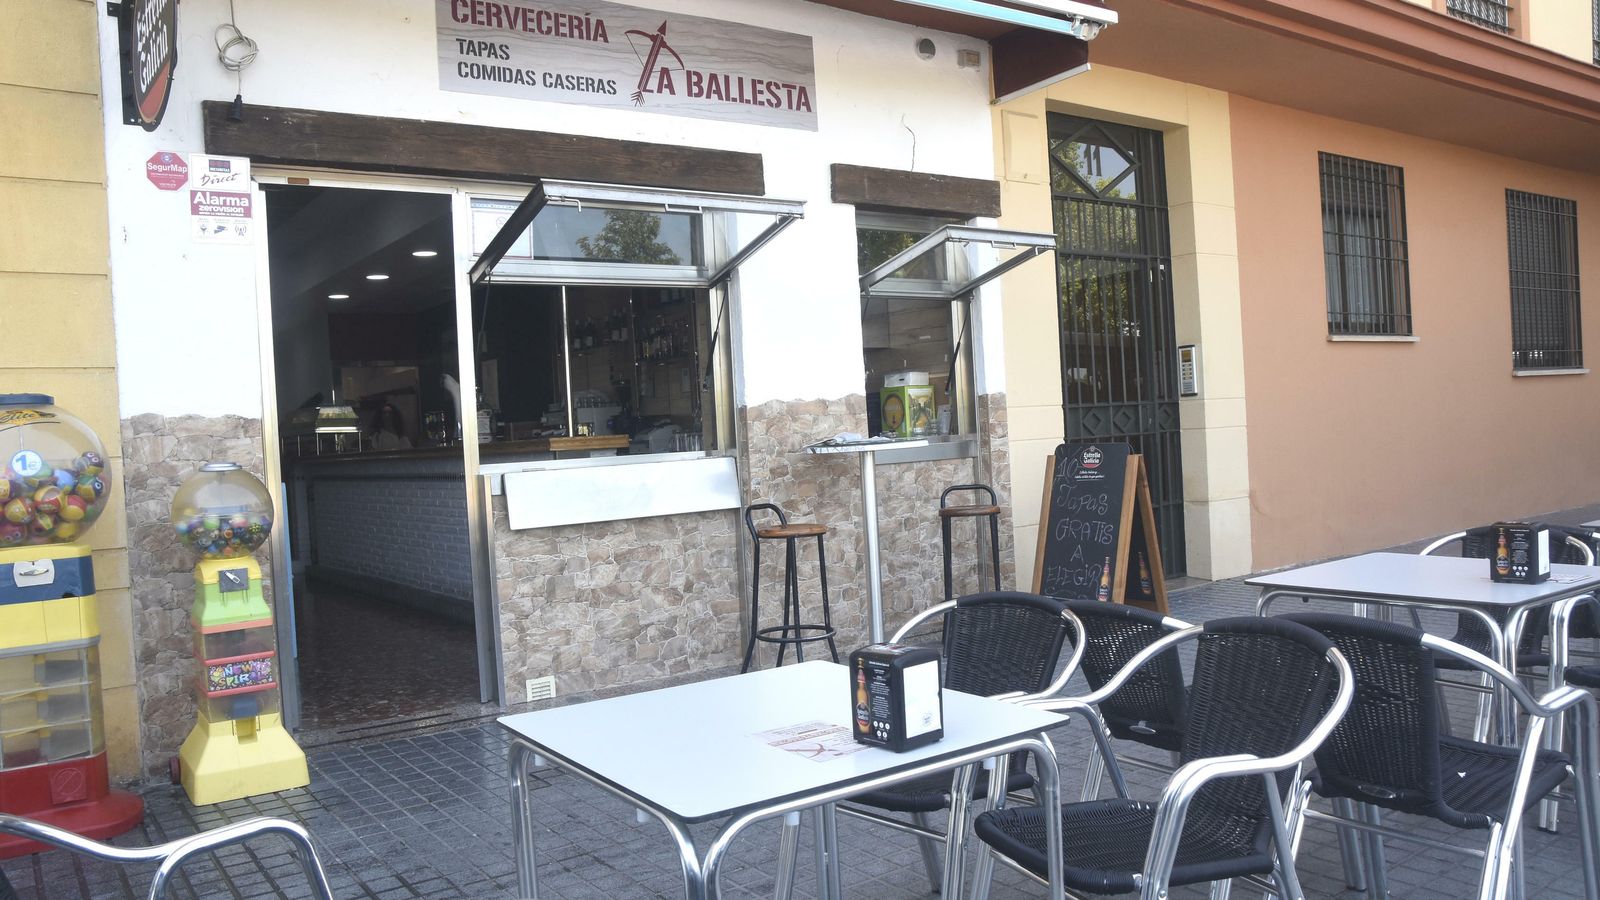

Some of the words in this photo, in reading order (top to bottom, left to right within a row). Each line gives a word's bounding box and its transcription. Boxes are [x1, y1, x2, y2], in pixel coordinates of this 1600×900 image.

[451, 0, 609, 43] CERVECERÍA
[140, 24, 168, 93] Galicia
[456, 38, 510, 60] TAPAS
[457, 61, 537, 87] COMIDAS
[542, 72, 617, 95] CASERAS
[686, 70, 812, 112] BALLESTA
[147, 162, 188, 173] SegurMap
[1084, 144, 1102, 176] 11
[200, 172, 240, 187] Direct
[193, 191, 249, 207] Alarma
[198, 204, 245, 214] zerovision
